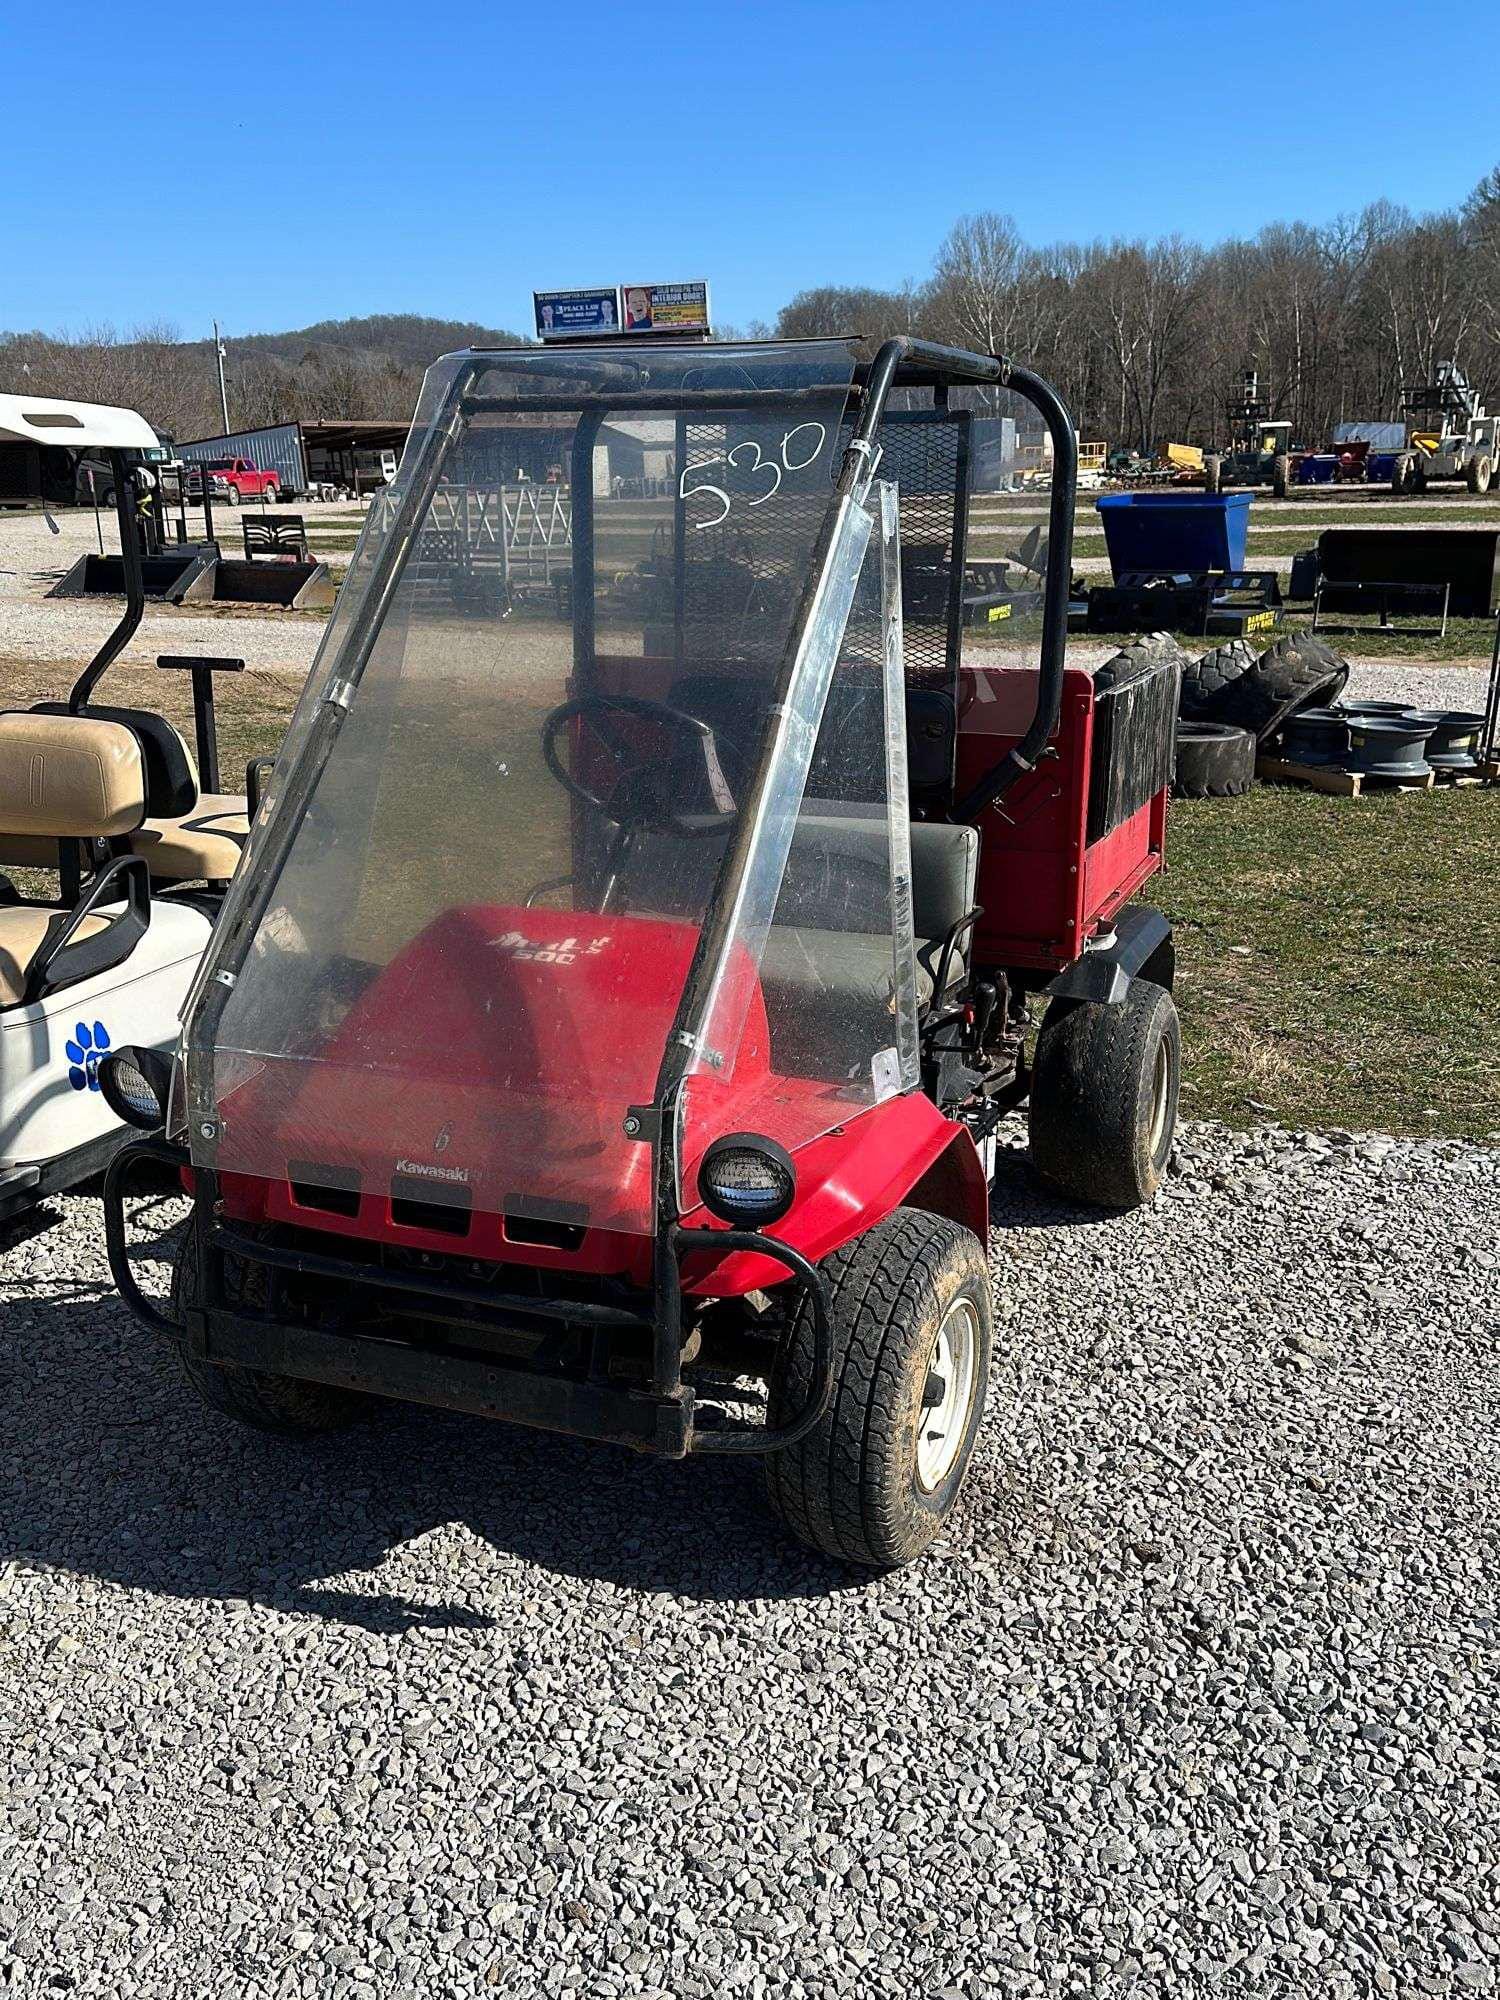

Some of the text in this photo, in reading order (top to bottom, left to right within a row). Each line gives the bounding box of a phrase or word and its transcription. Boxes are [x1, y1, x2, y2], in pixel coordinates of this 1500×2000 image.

[652, 292, 682, 303] INTERIOR
[563, 303, 599, 312] PEACE LAW
[680, 423, 826, 529] 530
[396, 1159, 469, 1182] Kawasaki
